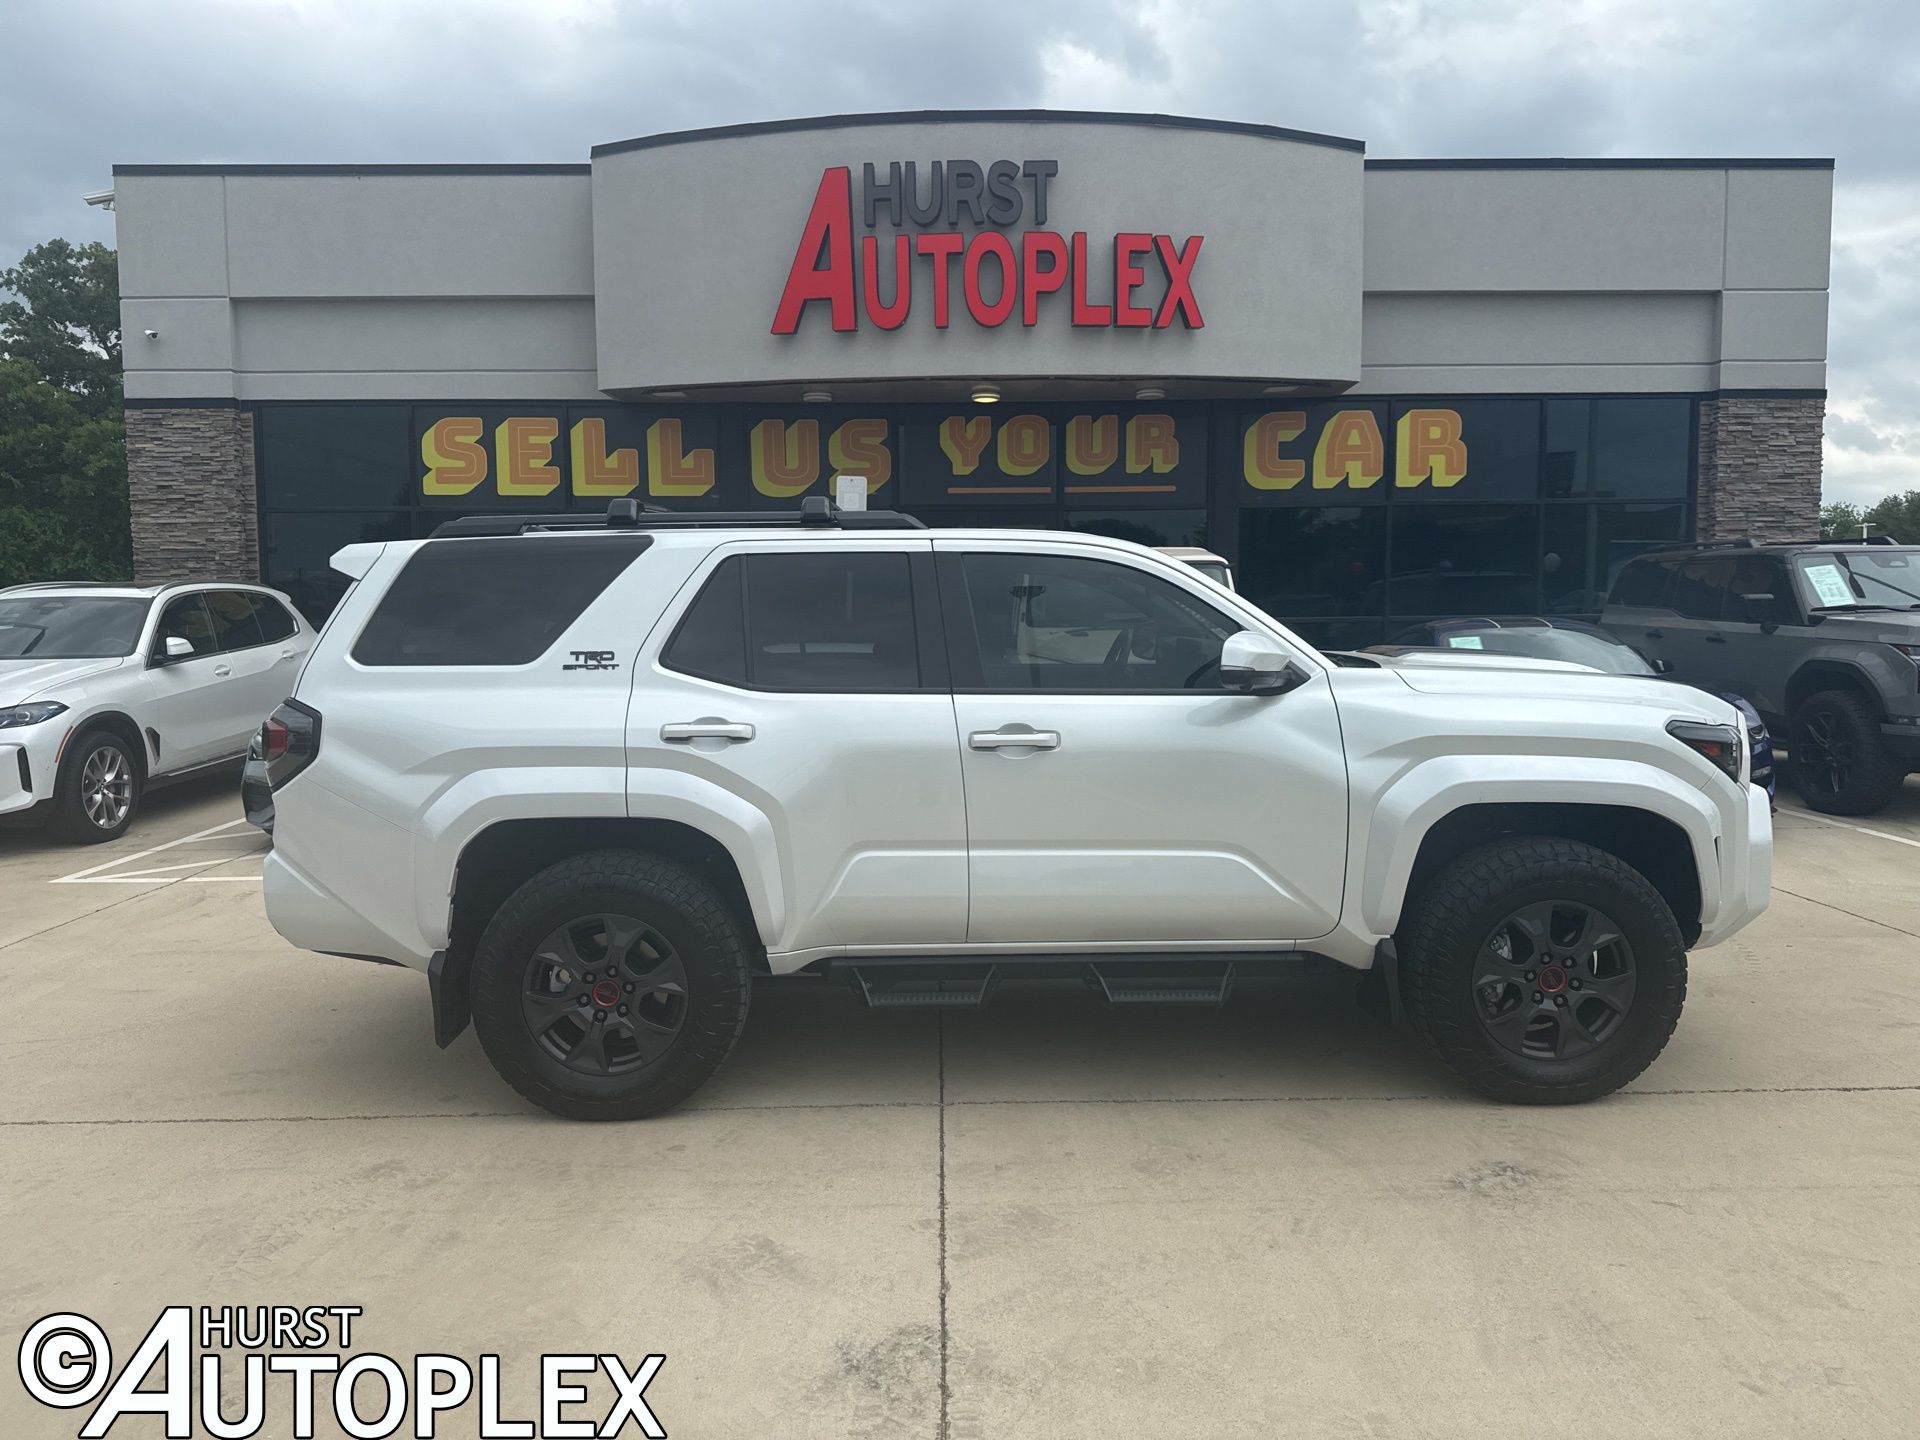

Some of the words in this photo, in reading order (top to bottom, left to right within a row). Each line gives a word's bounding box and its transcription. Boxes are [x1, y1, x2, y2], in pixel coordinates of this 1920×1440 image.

[863, 159, 1058, 227] HURST
[770, 166, 1205, 336] AUTOPLEX
[421, 416, 716, 497] SELL
[750, 417, 892, 498] US
[939, 414, 1180, 476] YOUR
[1243, 408, 1468, 490] CAR
[569, 650, 616, 664] TRD
